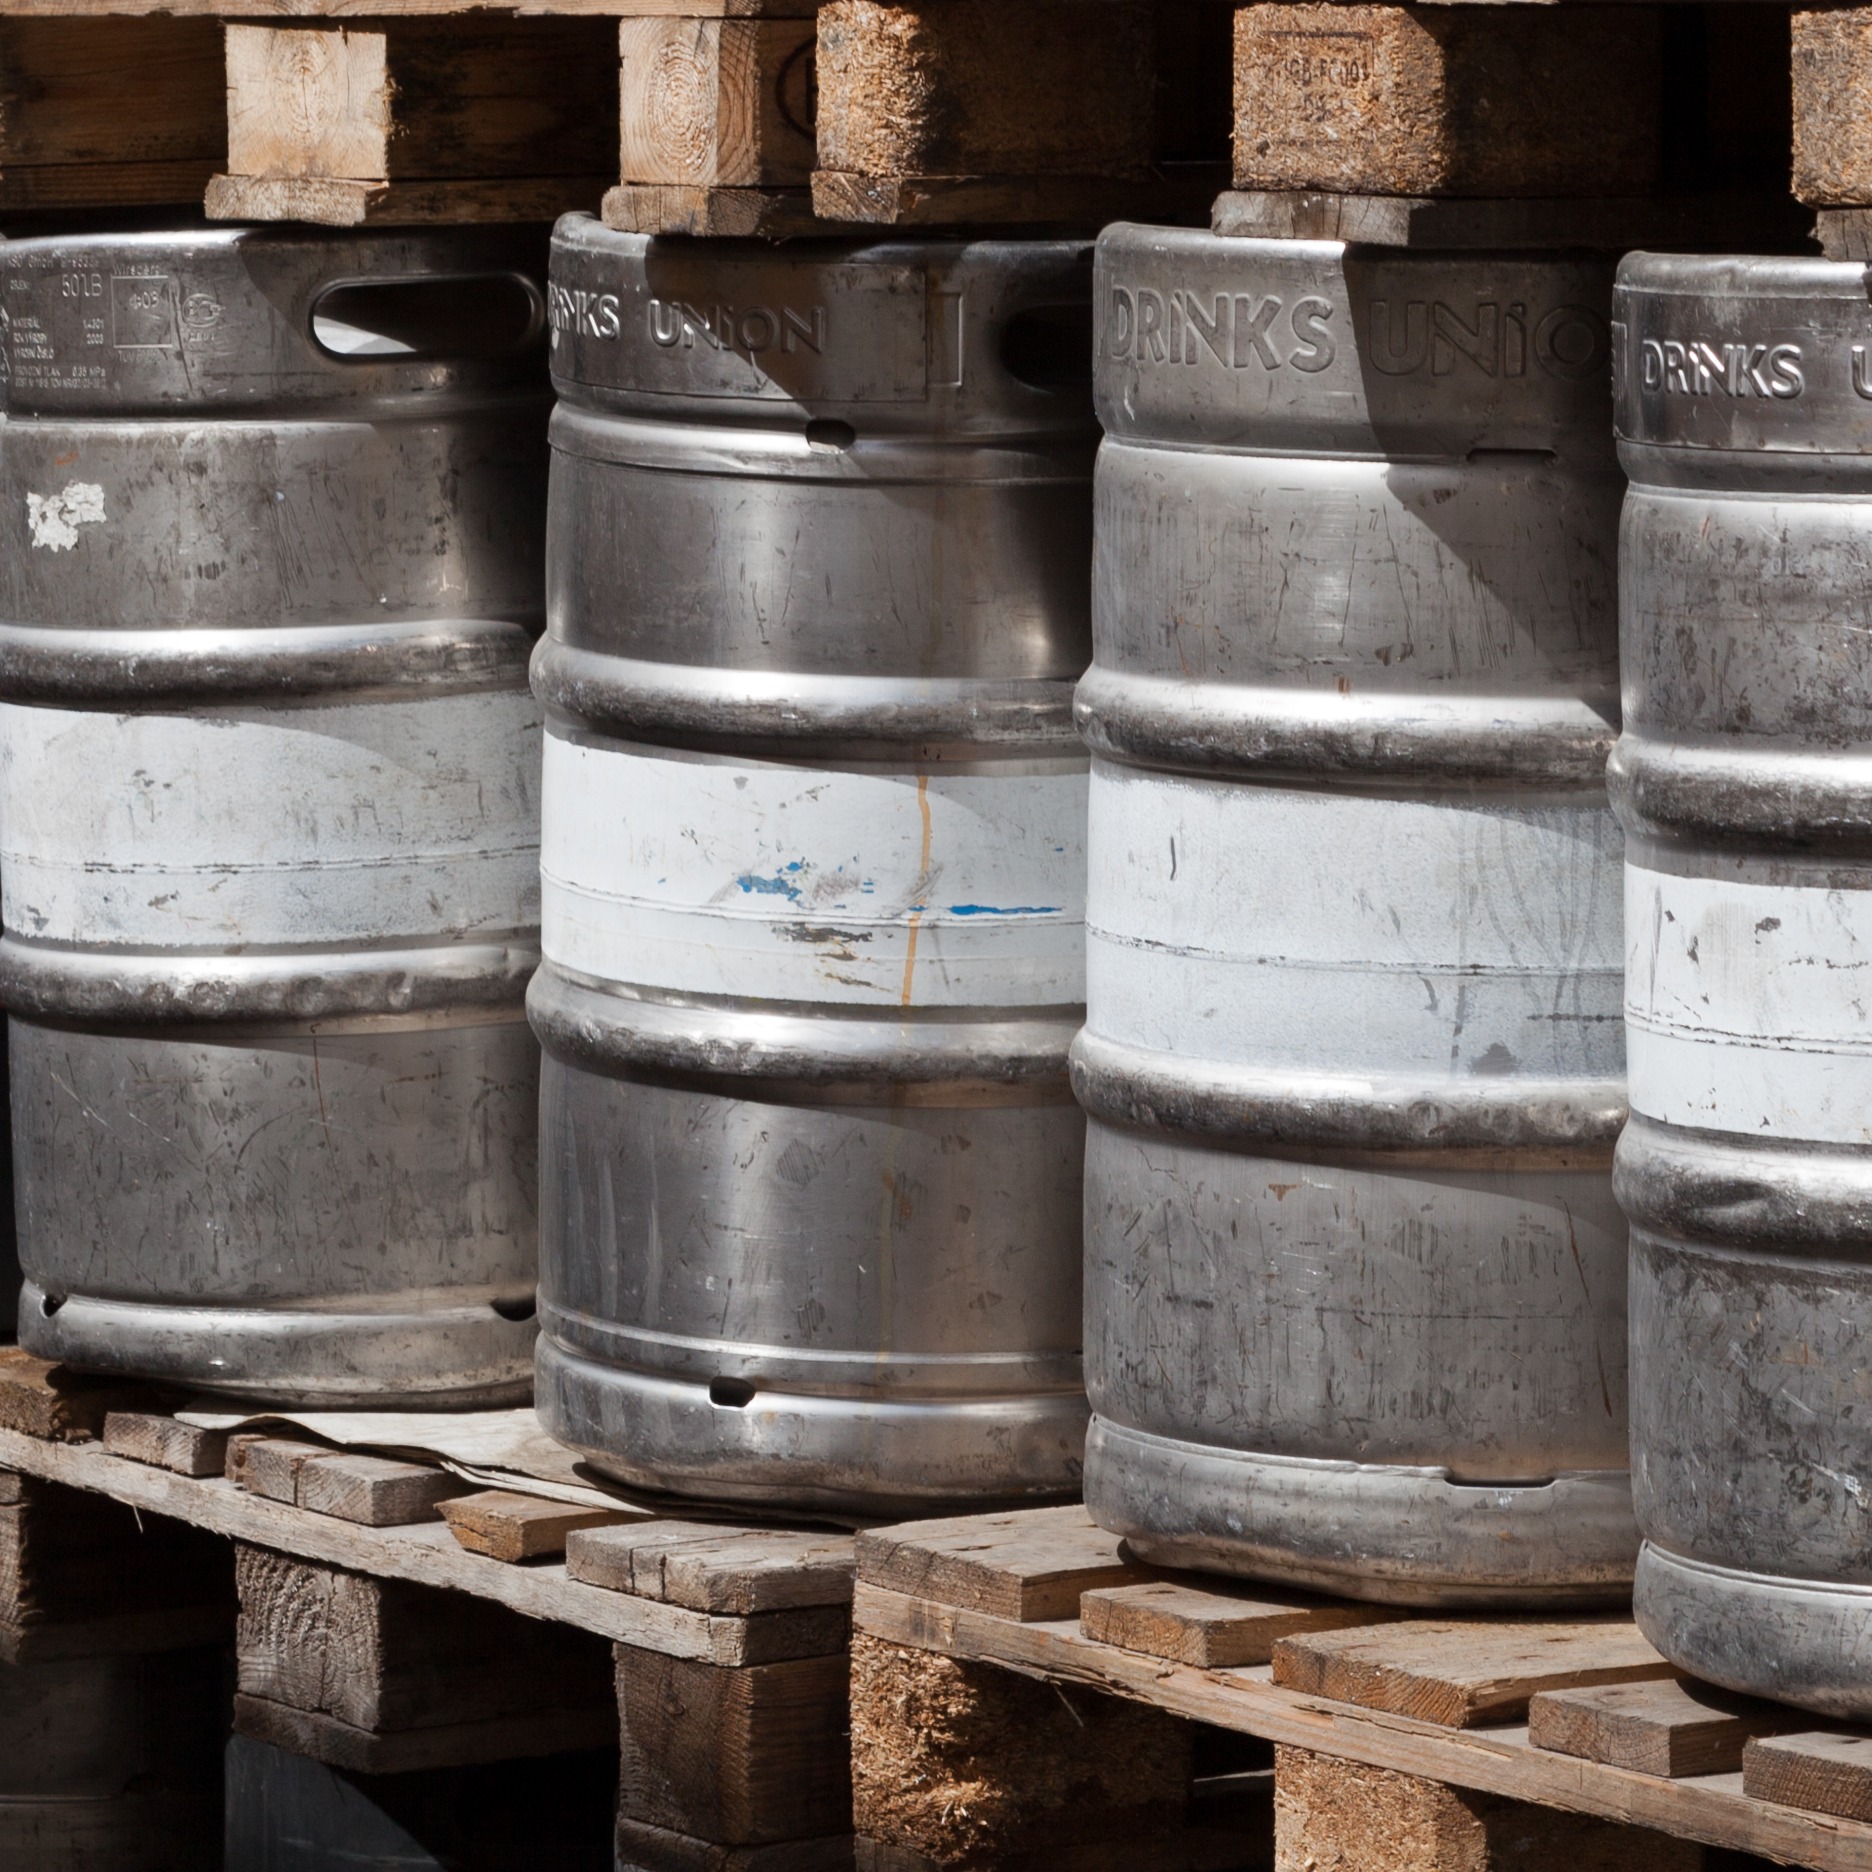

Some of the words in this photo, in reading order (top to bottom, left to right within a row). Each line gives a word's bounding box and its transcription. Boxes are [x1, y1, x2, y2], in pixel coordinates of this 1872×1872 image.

[646, 298, 825, 355] UNION
[1112, 285, 1337, 375] DRINKS
[1641, 338, 1805, 402] DRINKS
